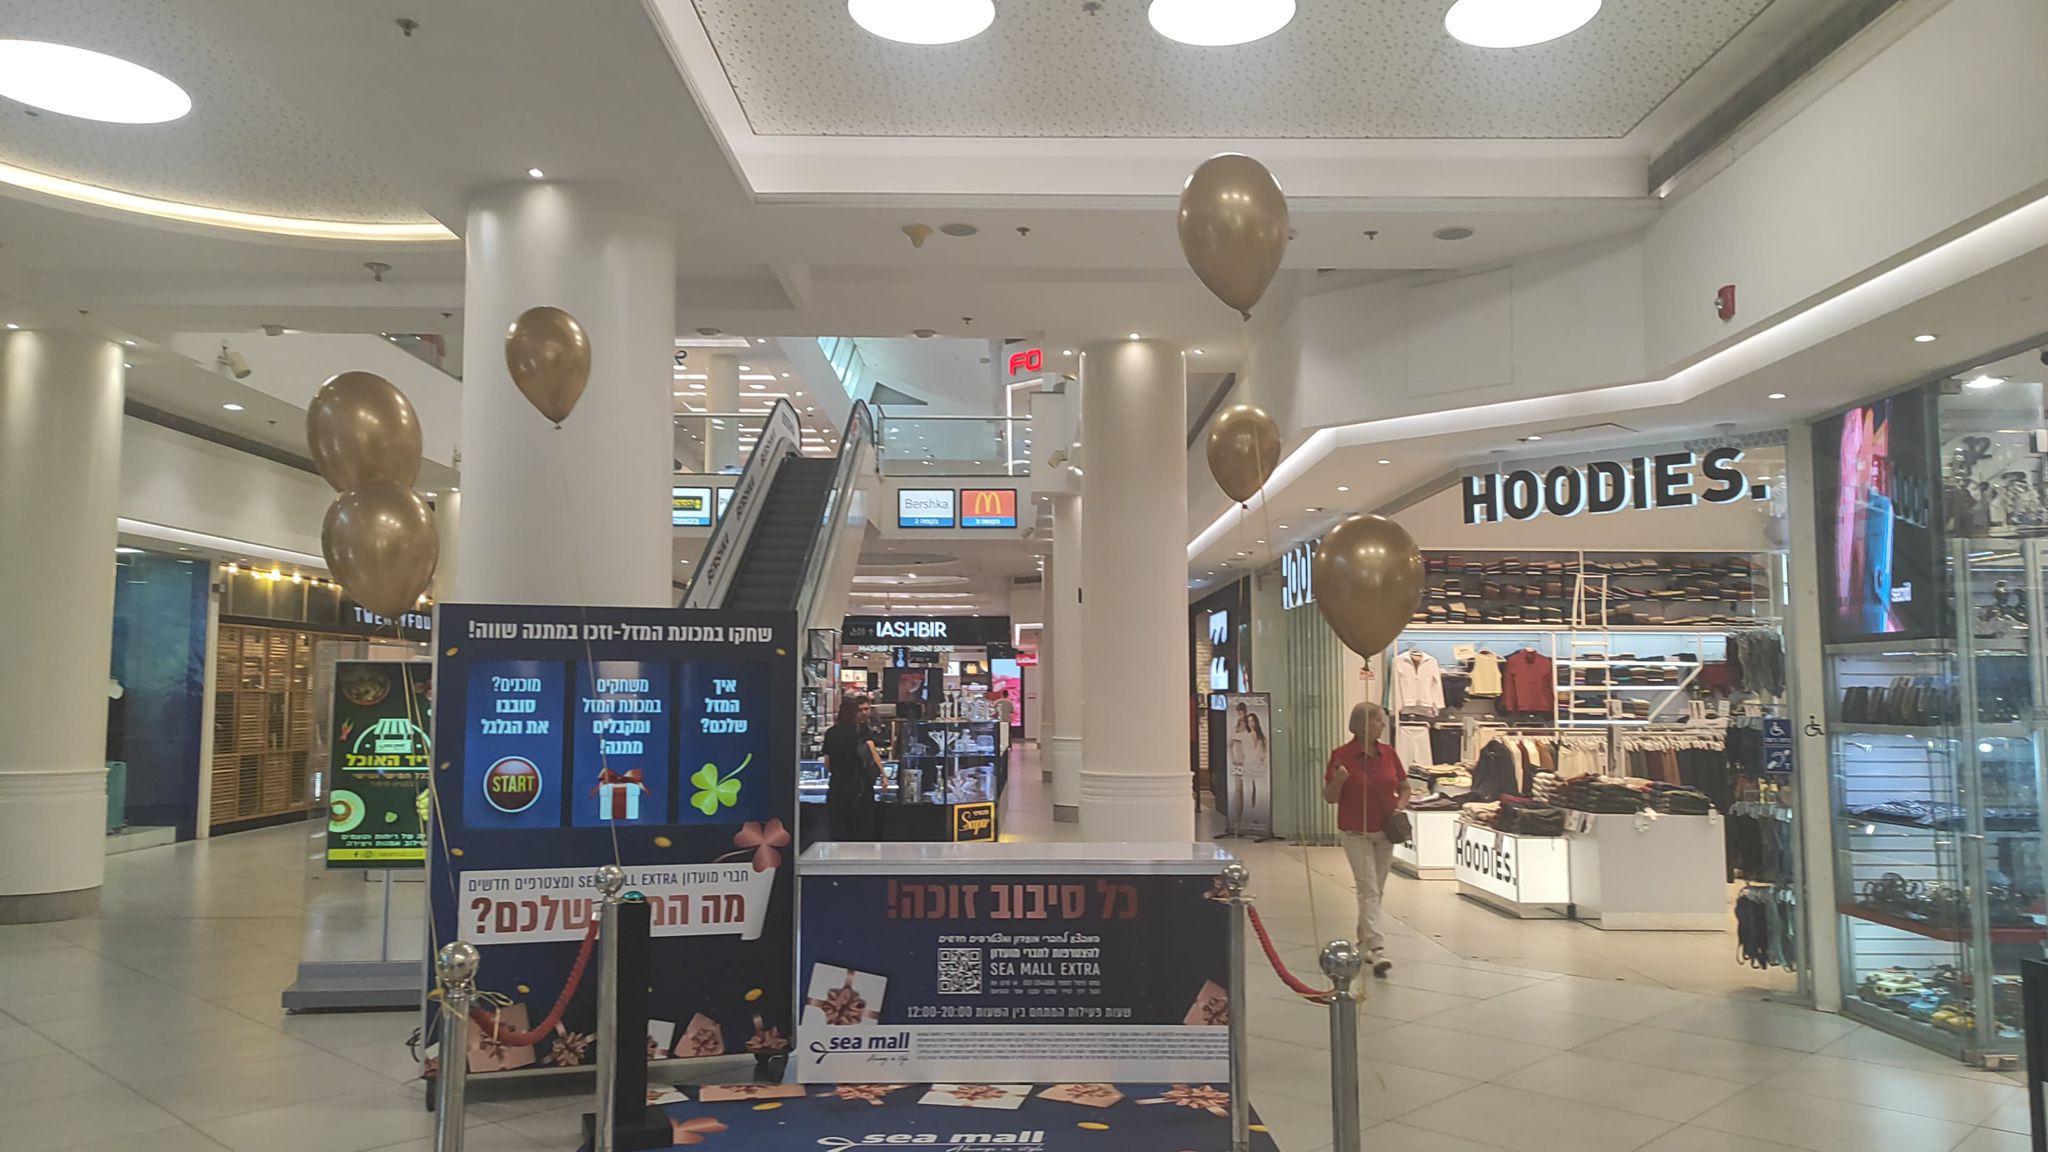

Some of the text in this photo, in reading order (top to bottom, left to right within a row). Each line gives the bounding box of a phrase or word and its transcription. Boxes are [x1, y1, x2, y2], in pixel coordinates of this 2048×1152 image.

[1463, 447, 1772, 524] HOODIES.
[904, 498, 949, 510] Bershka
[468, 620, 518, 639] שווה!
[522, 622, 579, 640] במתנה
[667, 624, 724, 642] במכונת
[728, 626, 773, 645] שחקו
[491, 676, 542, 692] מוכנים?
[596, 678, 649, 694] משחקים
[712, 679, 737, 695] איך
[496, 699, 536, 713] סובבו
[582, 697, 662, 713] במכונת המזל
[704, 697, 740, 713] המזל
[480, 718, 549, 734] את הגלגל
[592, 718, 651, 736] ומקבלים
[700, 717, 748, 733] שלכם?
[600, 738, 644, 755] מתנה!
[346, 753, 400, 767] האוכל
[492, 775, 536, 793] START
[514, 876, 574, 890] ומצטרפים
[641, 873, 678, 886] EXTRA
[682, 871, 718, 886] מועדון
[723, 870, 749, 882] חברי
[468, 878, 510, 892] חדשים
[887, 880, 1138, 919] כל סיבוב זוכה!
[470, 895, 594, 934] שלכם?
[701, 893, 745, 925] מה
[990, 962, 1101, 976] SEA MALL EXTRA
[829, 1036, 862, 1050] sea
[868, 1031, 911, 1050] mall
[861, 1130, 1045, 1144] sea mall
